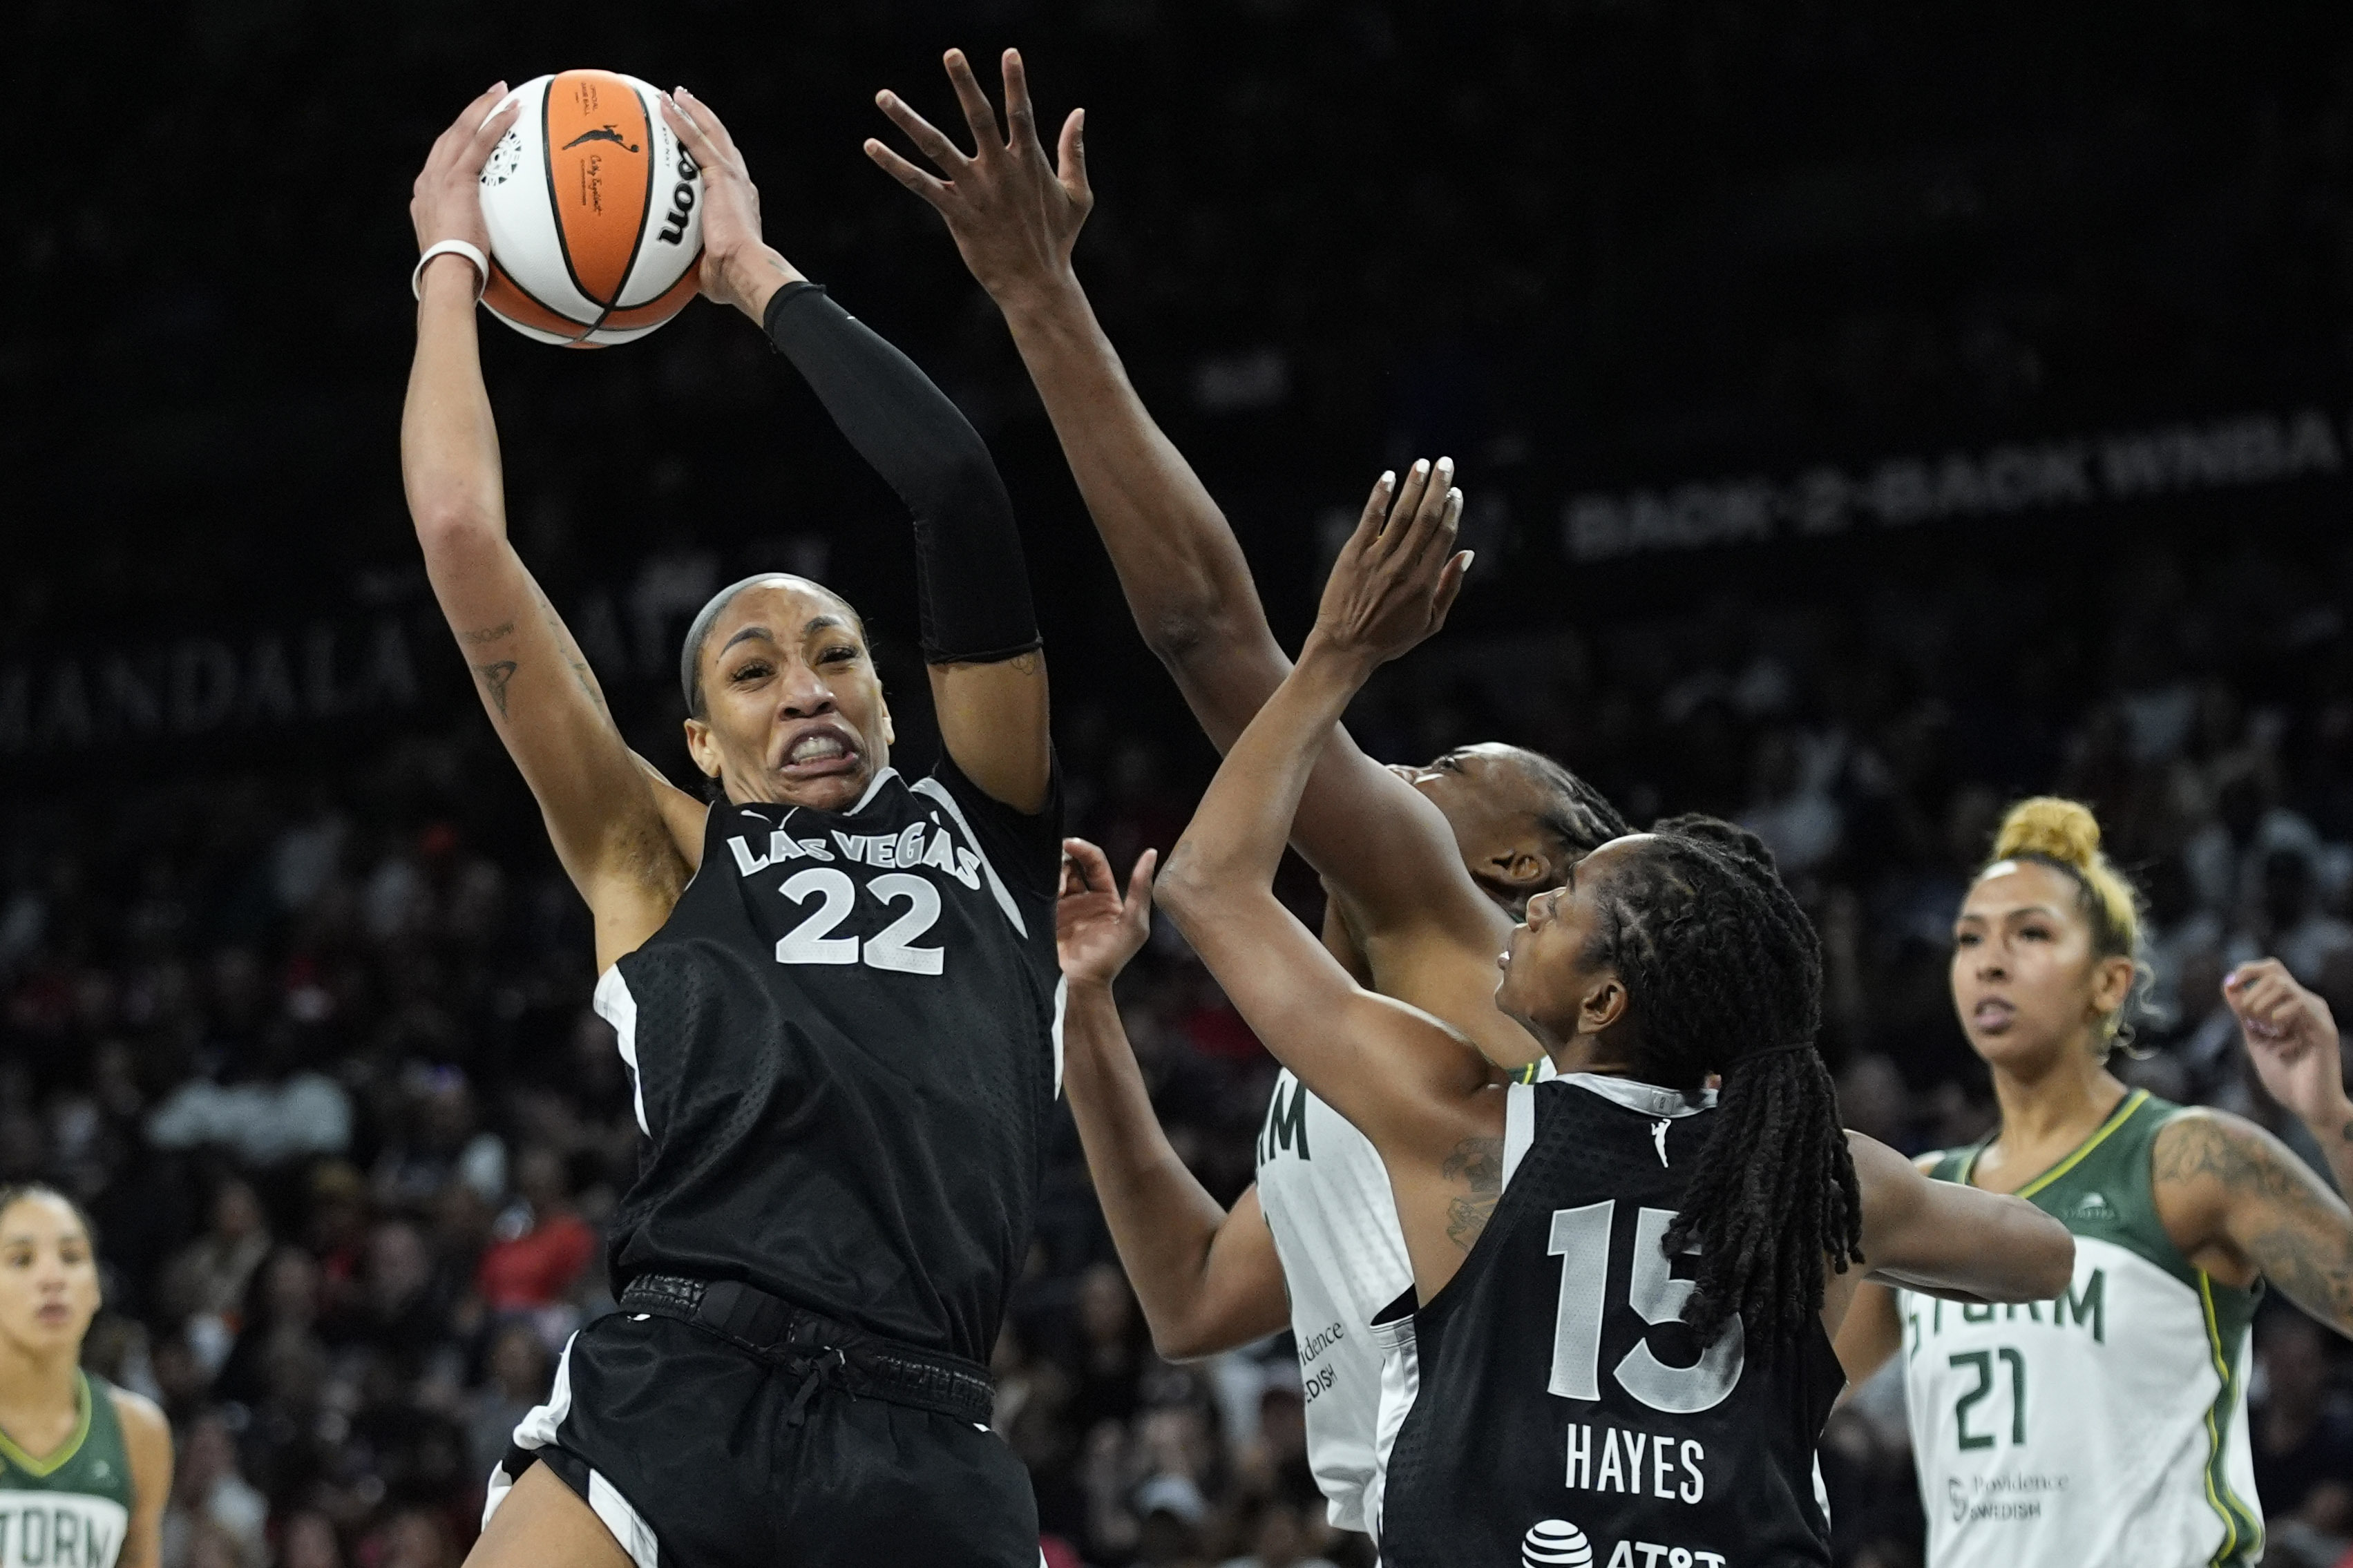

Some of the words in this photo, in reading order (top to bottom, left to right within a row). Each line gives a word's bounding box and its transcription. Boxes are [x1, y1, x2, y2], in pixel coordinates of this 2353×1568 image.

[656, 141, 699, 245] son
[2103, 409, 2341, 495] WNBA
[0, 617, 419, 753] ANDALA
[727, 829, 835, 877] LAS
[830, 821, 981, 891] VEGAS
[775, 867, 944, 975] 22
[1299, 1322, 1344, 1366] idence
[1546, 1199, 1745, 1414] 15
[1306, 1364, 1338, 1404] DISH
[1949, 1347, 2028, 1451] 21
[1565, 1423, 1705, 1504] HAYES
[0, 1507, 112, 1568] TORM
[1971, 1502, 2041, 1521] SWEDISH
